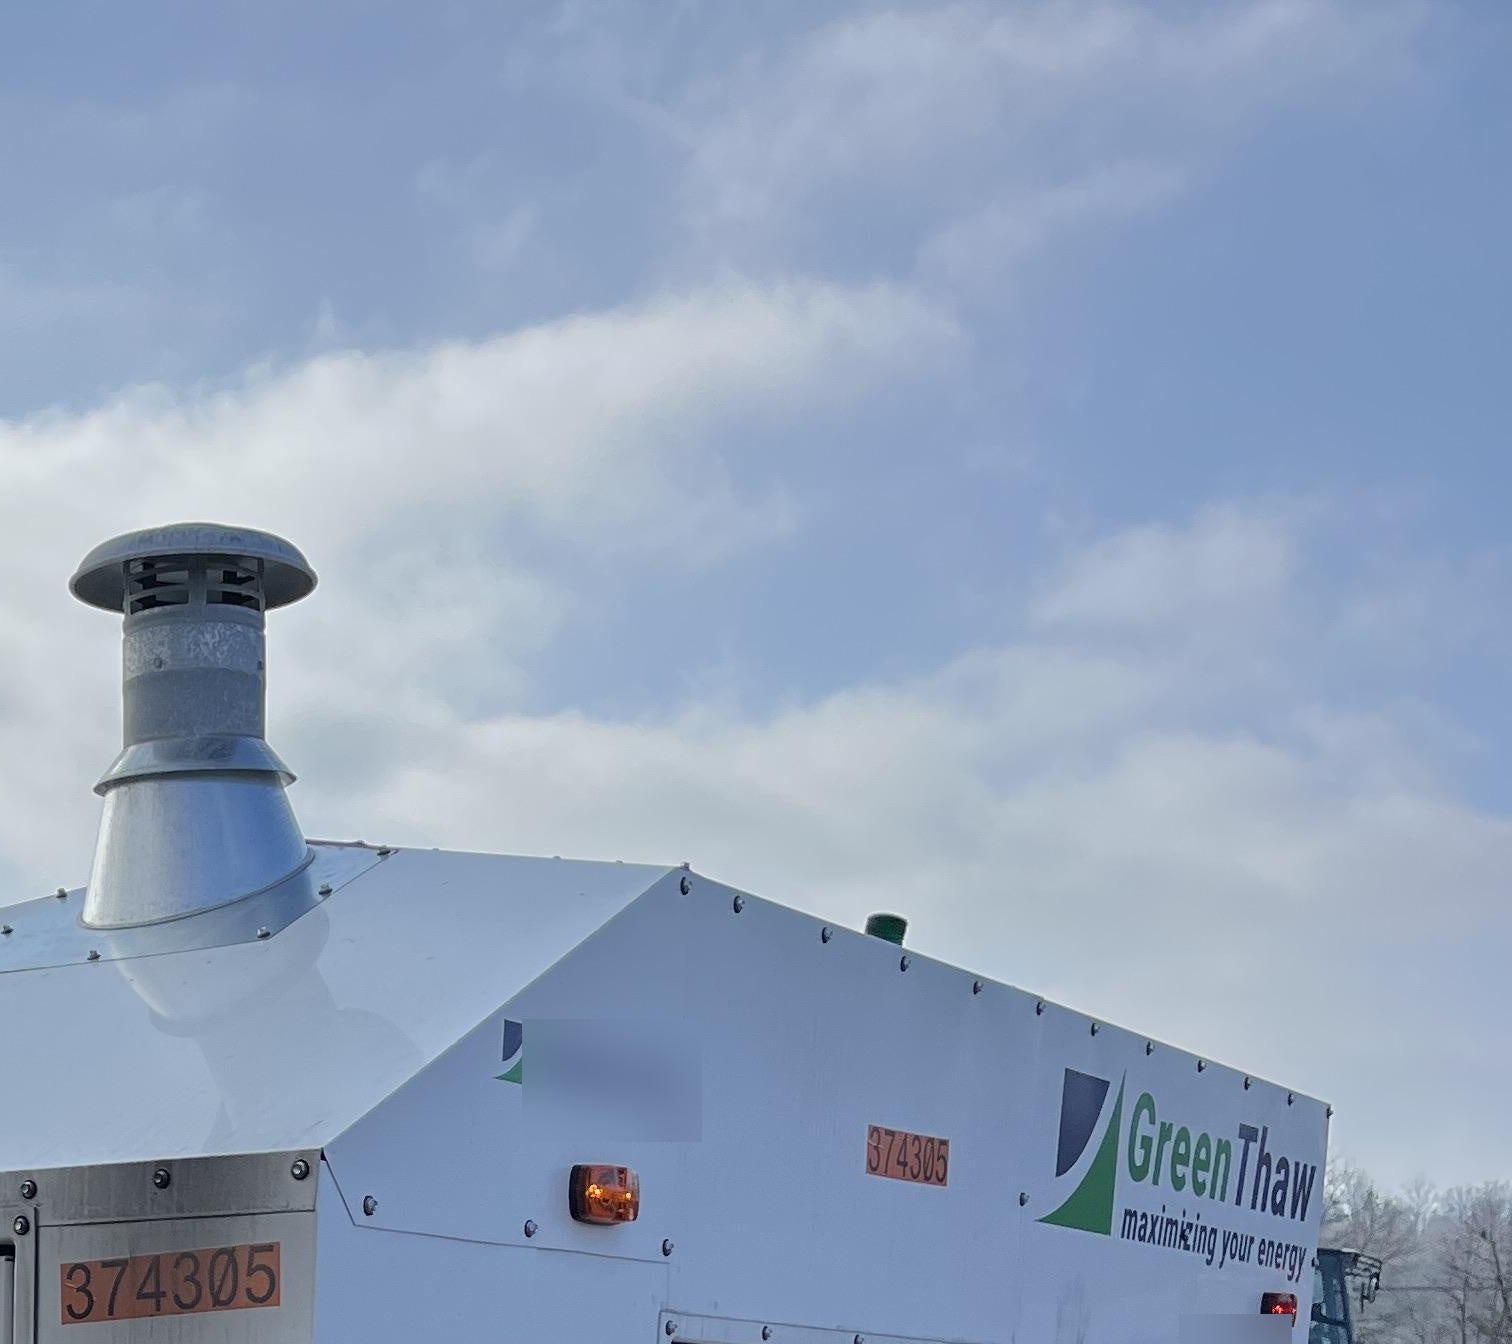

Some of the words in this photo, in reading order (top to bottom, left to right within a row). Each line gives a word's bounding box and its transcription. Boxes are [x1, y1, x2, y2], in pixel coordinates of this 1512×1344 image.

[869, 1126, 949, 1183] 374305
[66, 1244, 277, 1320] 374305
[1219, 1229, 1255, 1269] your
[1258, 1238, 1307, 1283] energy
